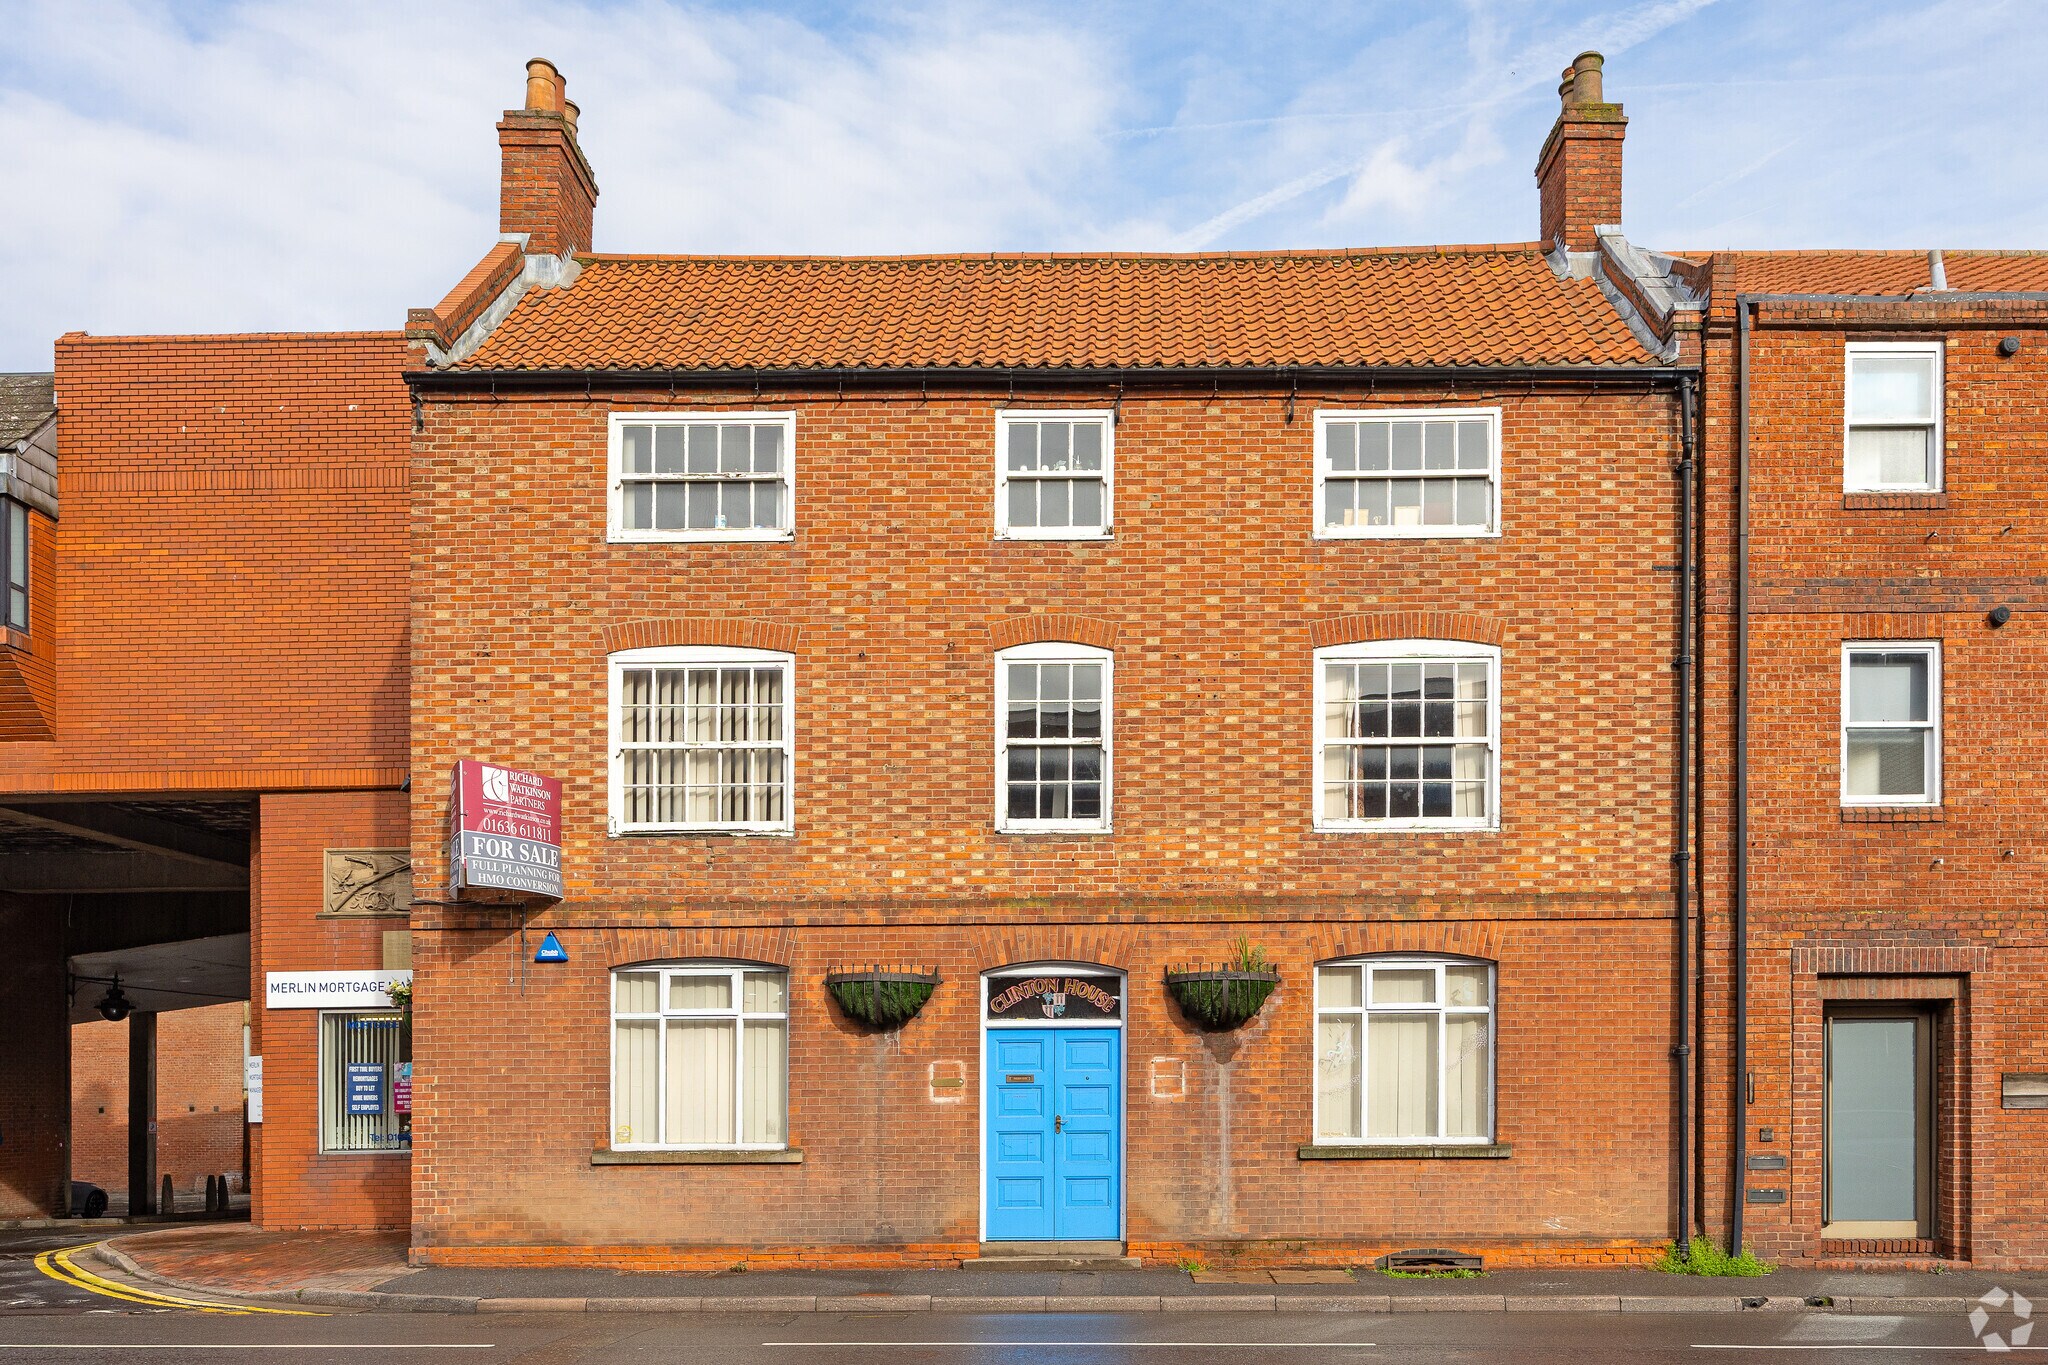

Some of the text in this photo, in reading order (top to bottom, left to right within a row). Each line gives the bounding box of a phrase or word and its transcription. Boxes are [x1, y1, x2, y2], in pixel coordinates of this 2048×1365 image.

[509, 771, 543, 787] RICHARD
[509, 782, 552, 800] WATKINSON
[510, 794, 546, 811] PARTNERS
[483, 807, 552, 826] www.richardwatkinson.co.uk
[483, 818, 552, 842] 01636 611811
[472, 836, 514, 860] FOR
[519, 843, 558, 868] SALE
[472, 859, 560, 883] FULL PLANNING FOR
[478, 872, 505, 885] HMO
[506, 875, 559, 894] CONVERSION
[270, 982, 316, 993] MERLIN
[319, 981, 385, 993] MORTGAGE
[990, 977, 1116, 1014] CLINTON HOUSE
[347, 1020, 399, 1029] MORTGAGE
